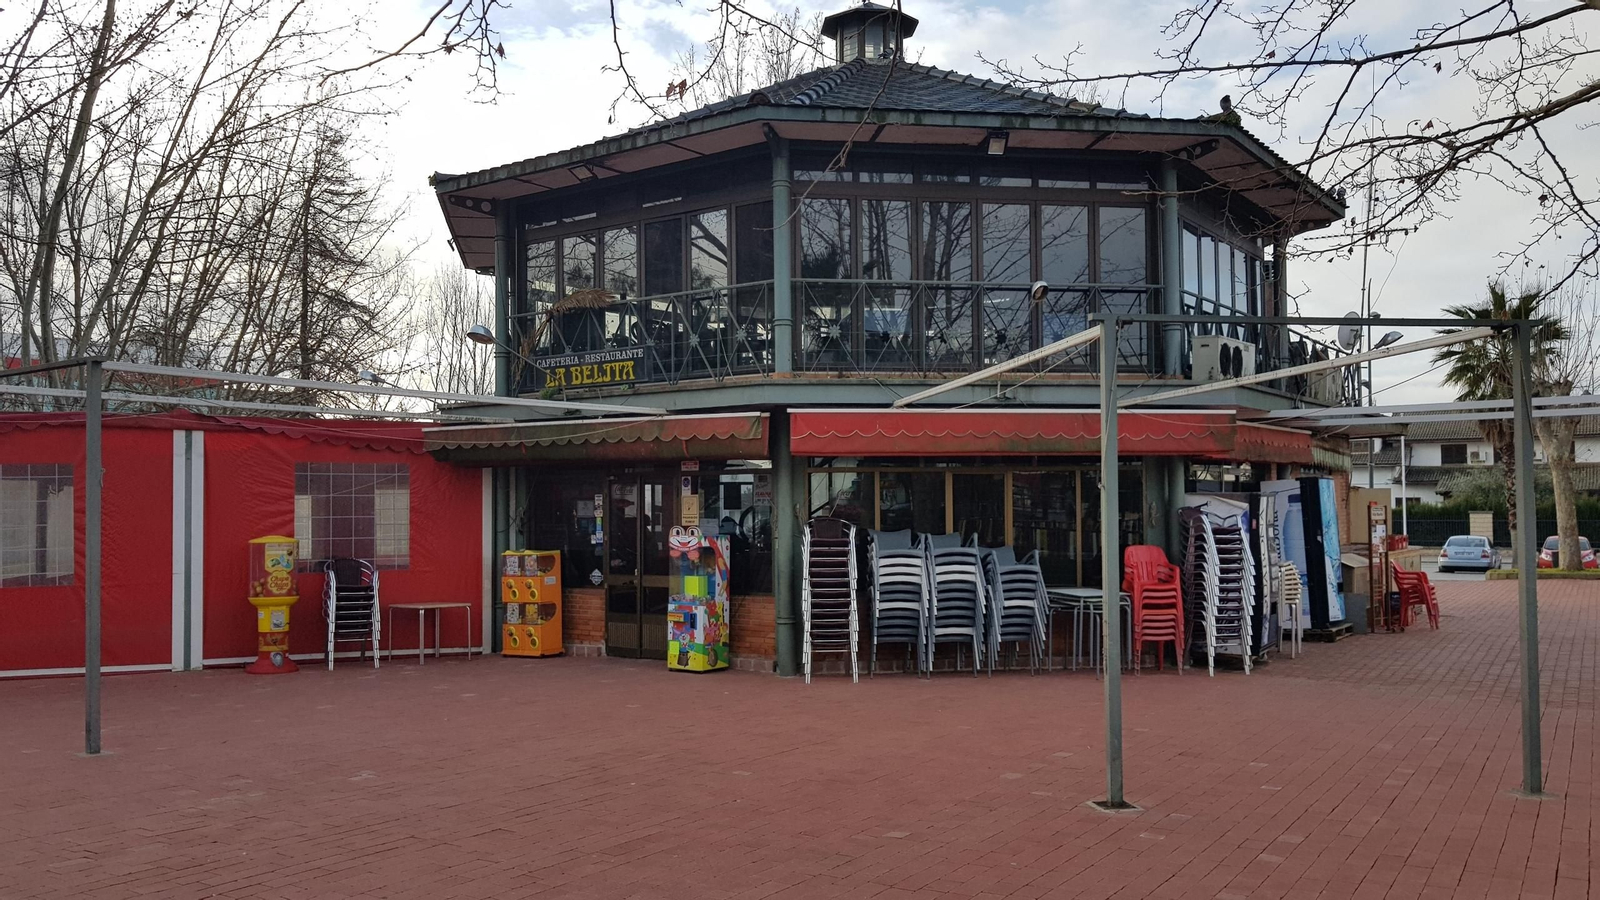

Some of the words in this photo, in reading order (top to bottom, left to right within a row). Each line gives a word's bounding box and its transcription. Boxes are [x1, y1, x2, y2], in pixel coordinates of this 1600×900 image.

[536, 356, 580, 368] CAFETERIA
[585, 348, 644, 363] RESTAURANTE
[545, 367, 567, 387] LA
